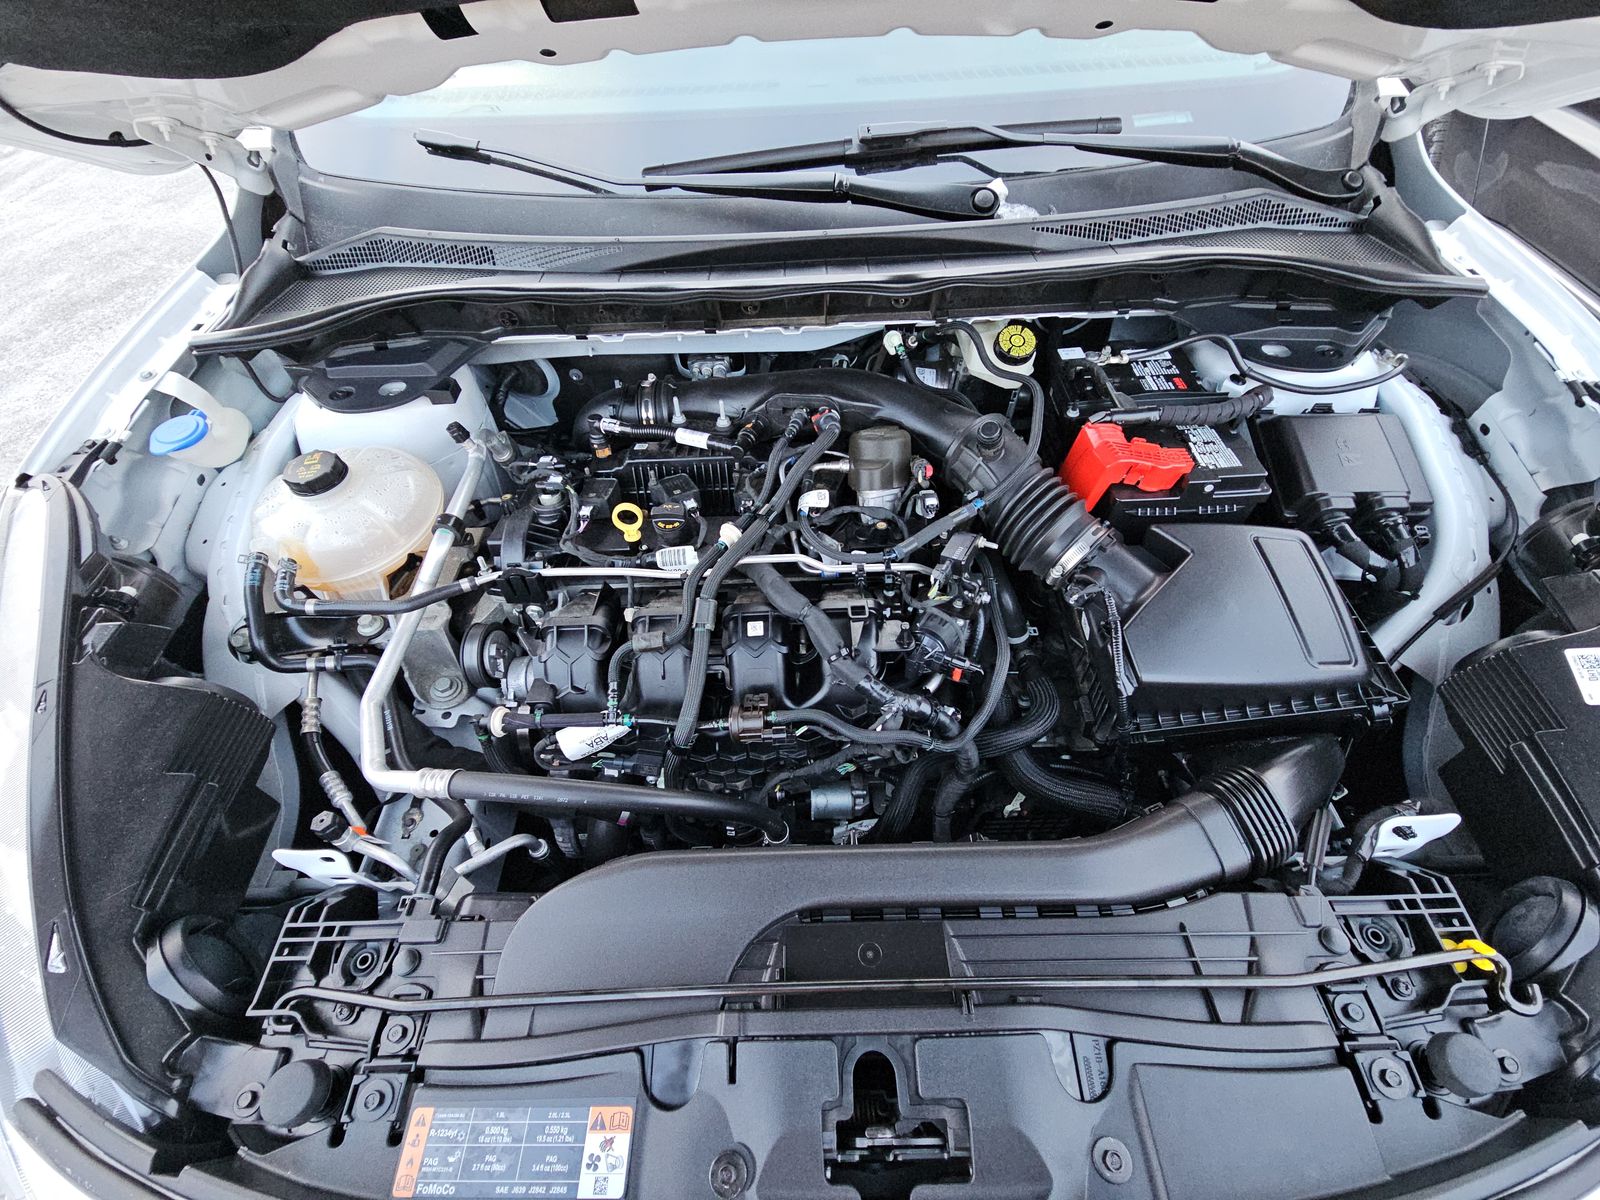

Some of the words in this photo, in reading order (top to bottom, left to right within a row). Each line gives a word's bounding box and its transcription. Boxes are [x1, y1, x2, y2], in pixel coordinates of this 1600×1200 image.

[429, 1128, 458, 1139] R-1234yf
[485, 1126, 500, 1135] 0.500
[501, 1126, 509, 1136] kg
[544, 1126, 560, 1135] 0.550
[561, 1126, 568, 1136] kg
[423, 1157, 438, 1166] PAG
[485, 1155, 497, 1163] PAG
[546, 1155, 558, 1163] PAG
[416, 1184, 455, 1195] FoMoCo
[495, 1186, 509, 1194] SAE
[511, 1186, 526, 1194] J639
[528, 1186, 546, 1194] J2842
